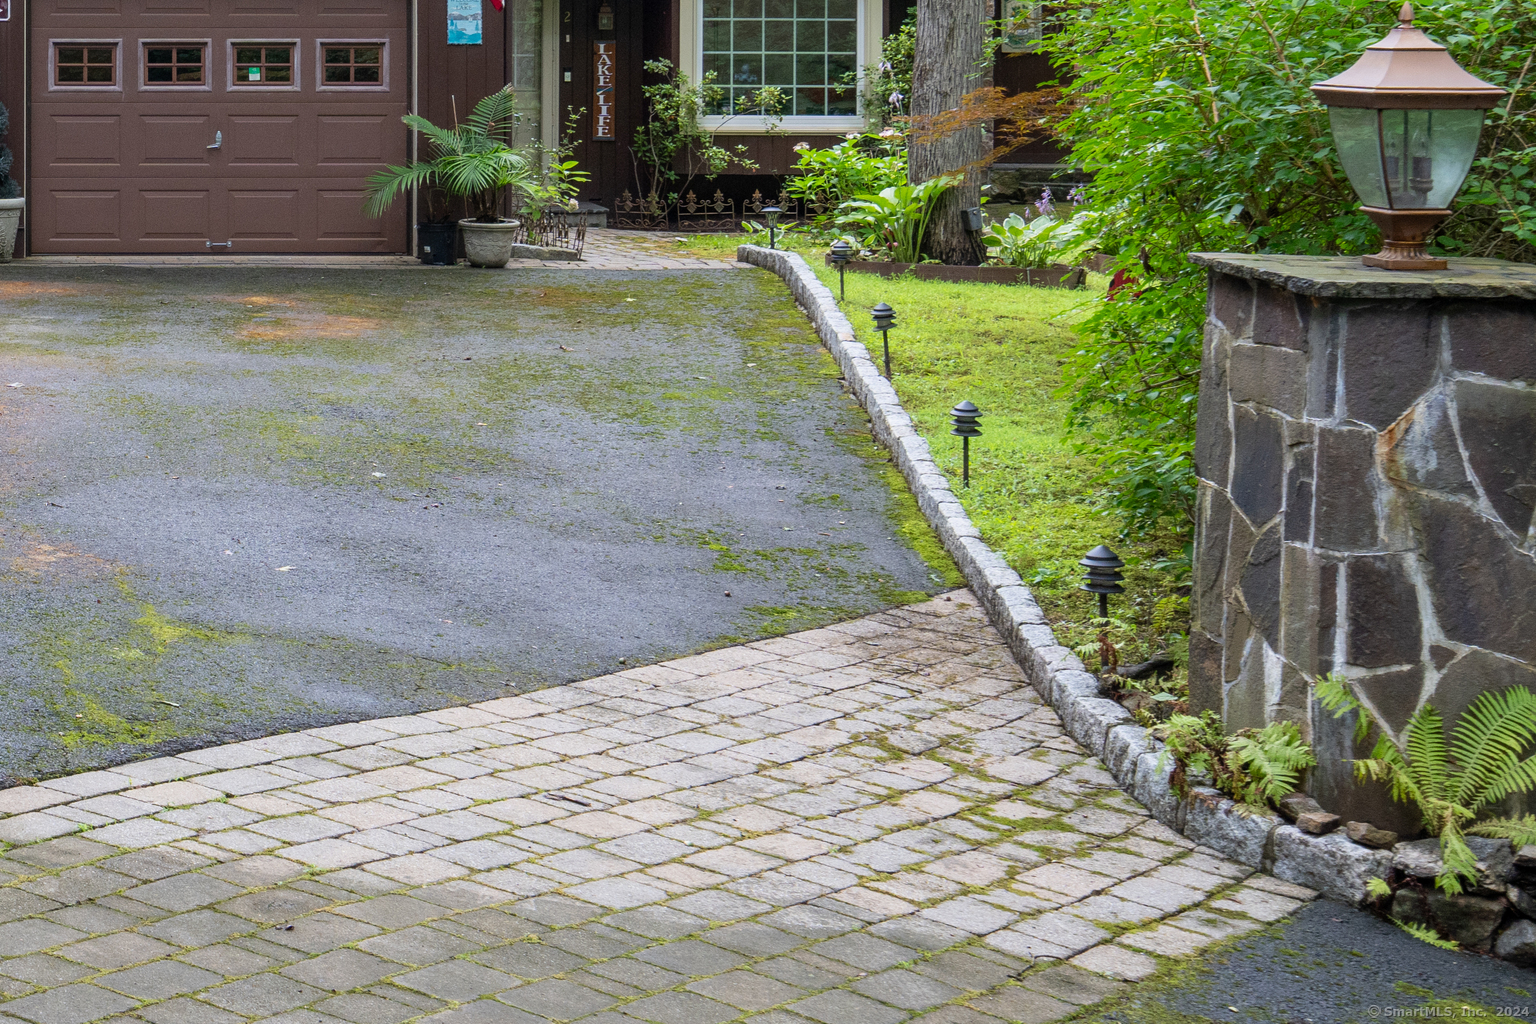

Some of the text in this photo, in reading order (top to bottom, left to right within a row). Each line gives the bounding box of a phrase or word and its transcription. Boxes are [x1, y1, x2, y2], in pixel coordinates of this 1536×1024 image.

[564, 11, 571, 23] 2
[597, 43, 613, 86] LAKE
[596, 94, 613, 137] LIFE
